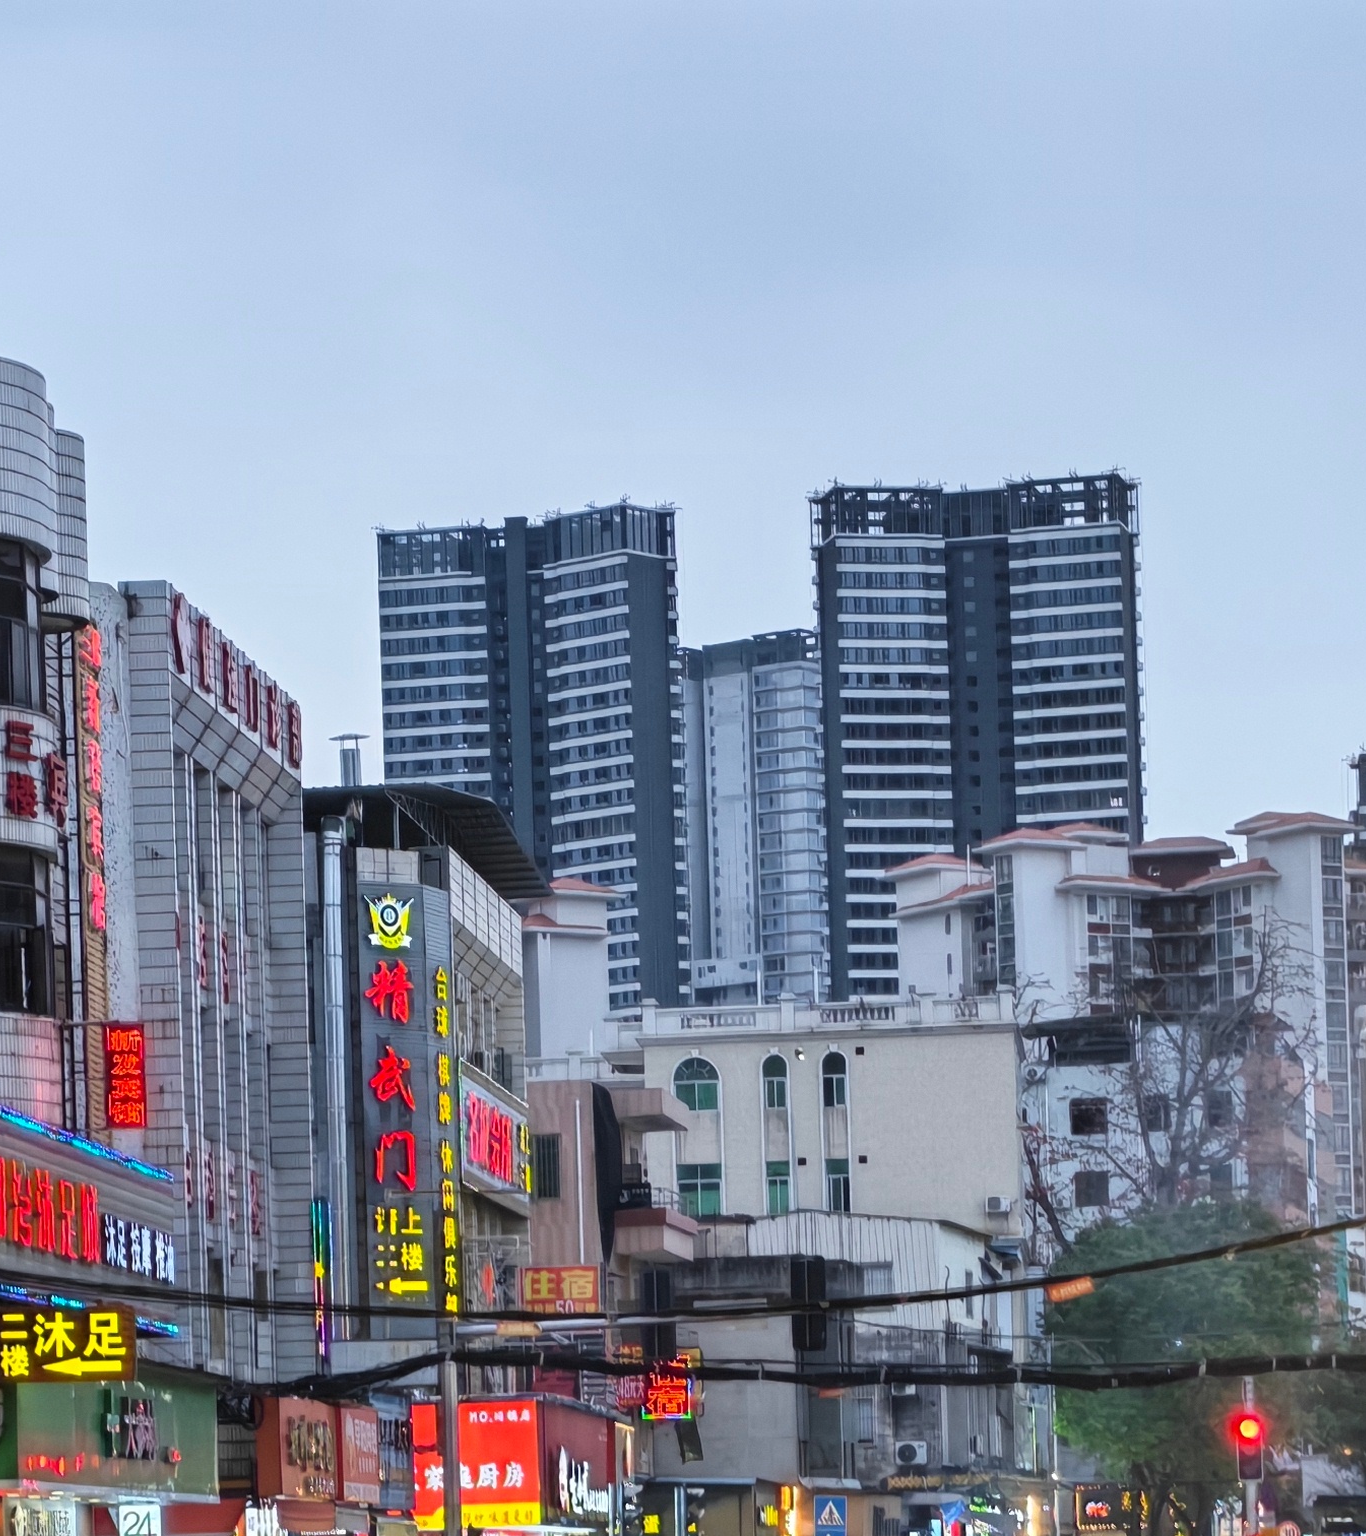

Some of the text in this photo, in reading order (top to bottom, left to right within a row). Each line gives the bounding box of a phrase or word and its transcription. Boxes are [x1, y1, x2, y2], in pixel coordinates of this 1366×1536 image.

[435, 966, 450, 1038] 台球
[364, 959, 416, 1192] 精武门
[437, 1053, 451, 1126] 棋牌
[525, 1270, 595, 1300] 住宿
[0, 1313, 30, 1377] 二楼
[33, 1312, 127, 1358] 沐足
[413, 1462, 524, 1493] 家庭厨房
